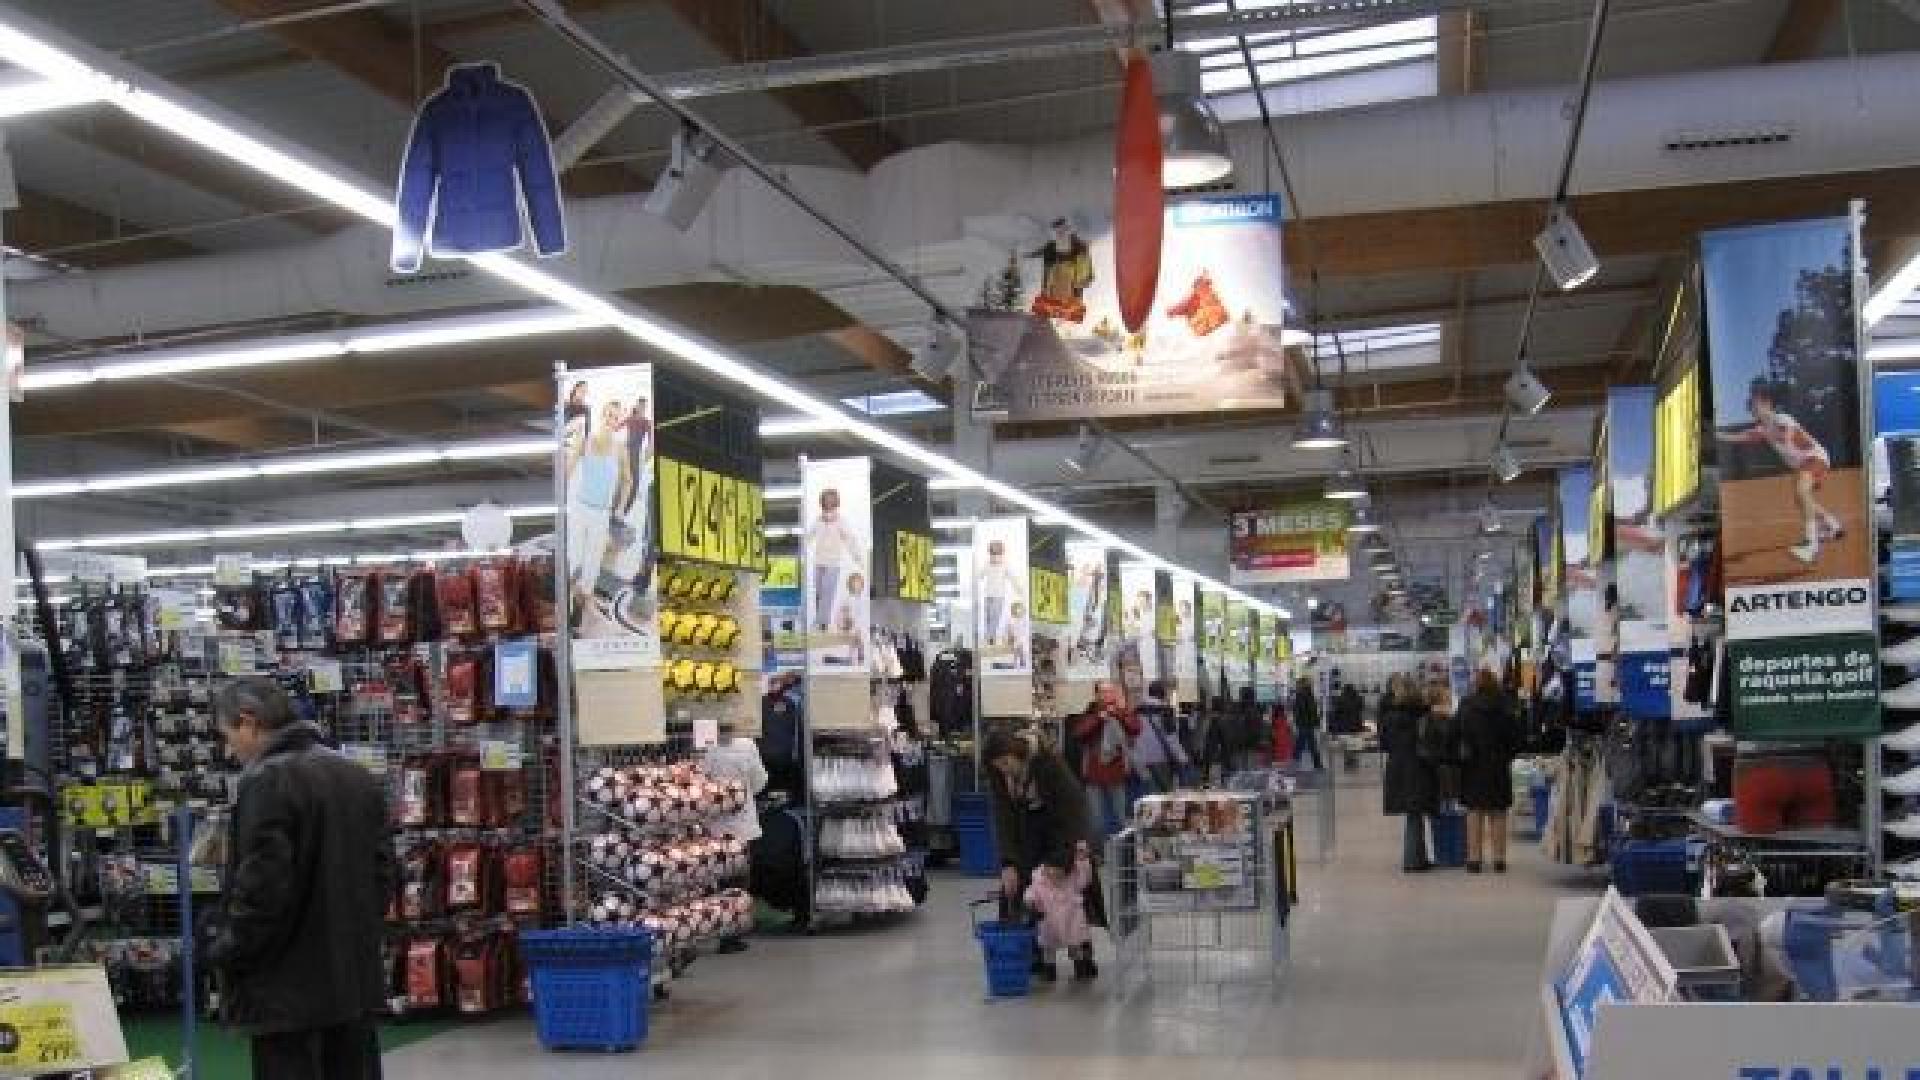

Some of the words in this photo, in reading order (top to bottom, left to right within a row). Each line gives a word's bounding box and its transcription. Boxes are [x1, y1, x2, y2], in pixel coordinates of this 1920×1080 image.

[1233, 512, 1249, 538] 3
[1730, 587, 1867, 613] ARTENGO
[1739, 654, 1837, 673] deportes
[1844, 650, 1873, 668] de
